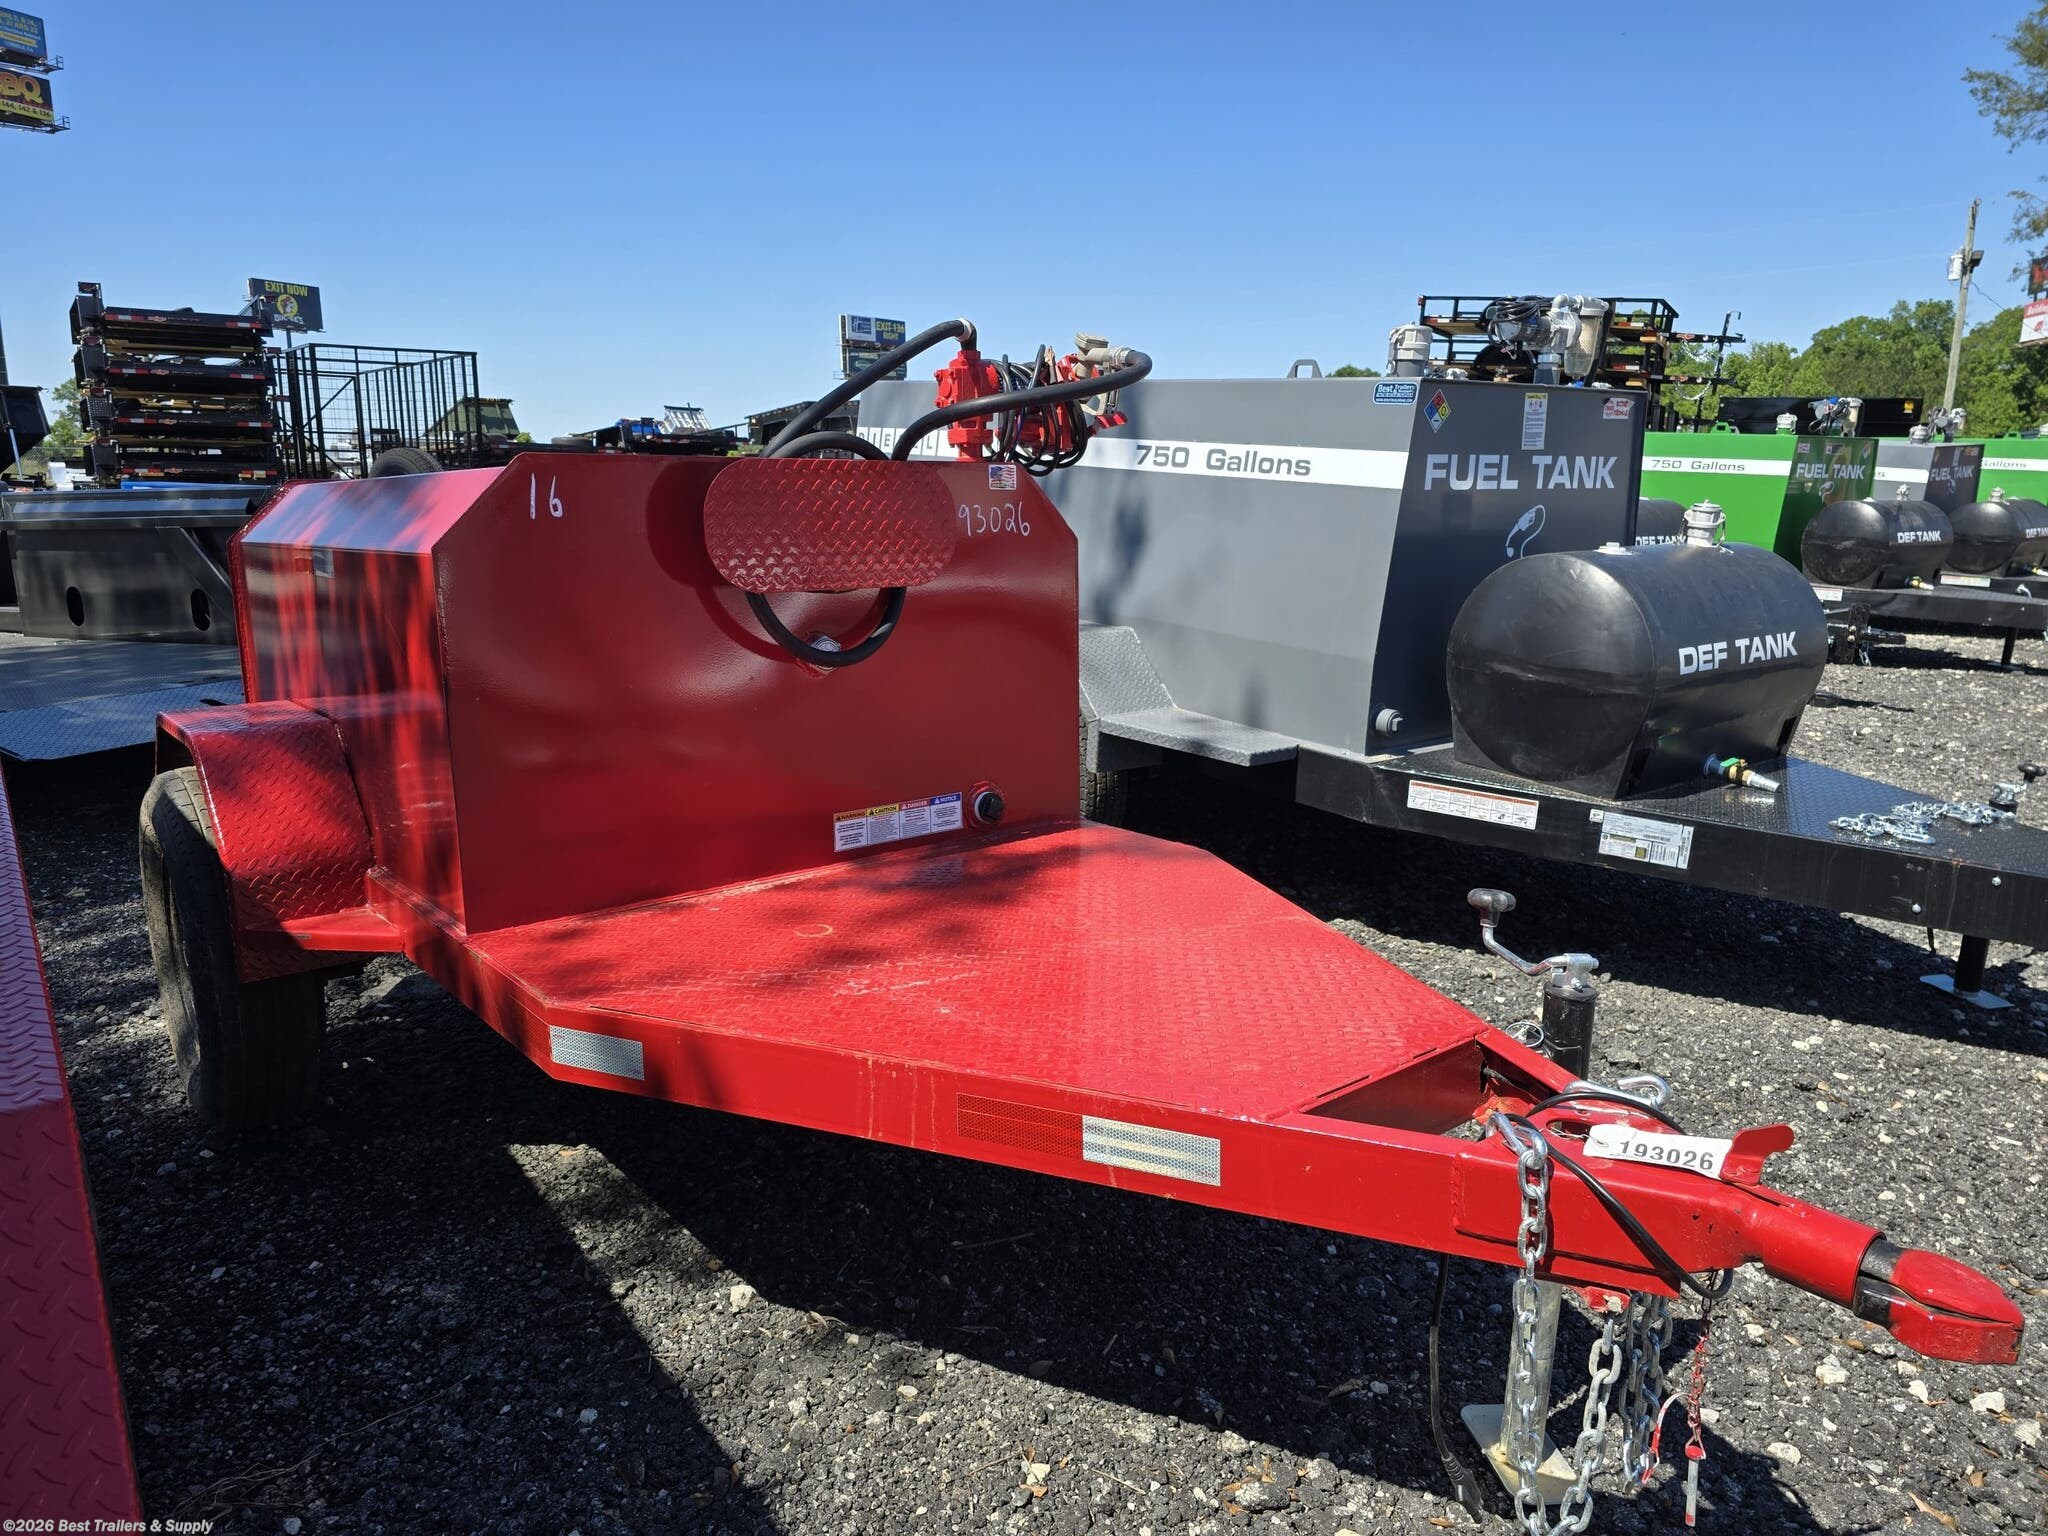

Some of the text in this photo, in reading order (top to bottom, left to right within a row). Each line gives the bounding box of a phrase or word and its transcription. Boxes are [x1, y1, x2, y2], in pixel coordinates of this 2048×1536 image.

[264, 281, 308, 297] EXIT NOW
[876, 321, 891, 332] EXIT
[1377, 383, 1394, 393] Best
[1136, 444, 1311, 476] 750 Gallons
[1650, 459, 1745, 472] 750 Gallons
[1424, 454, 1618, 491] FUEL TANK
[1795, 463, 1829, 479] FUEL
[1833, 464, 1866, 479] TANK
[1930, 465, 1974, 481] FUEL TANK
[530, 472, 563, 520] 16
[959, 501, 1031, 537] 93026
[1897, 530, 1942, 543] DEF TANK
[2025, 528, 2037, 539] DEF
[1635, 535, 1656, 546] DEF
[1678, 631, 1798, 675] DEF TANK
[907, 800, 928, 809] DANGER
[940, 795, 957, 803] NOTICE
[841, 812, 866, 820] WARNING
[874, 805, 897, 814] CAUTION
[1620, 1140, 1714, 1170] 193026
